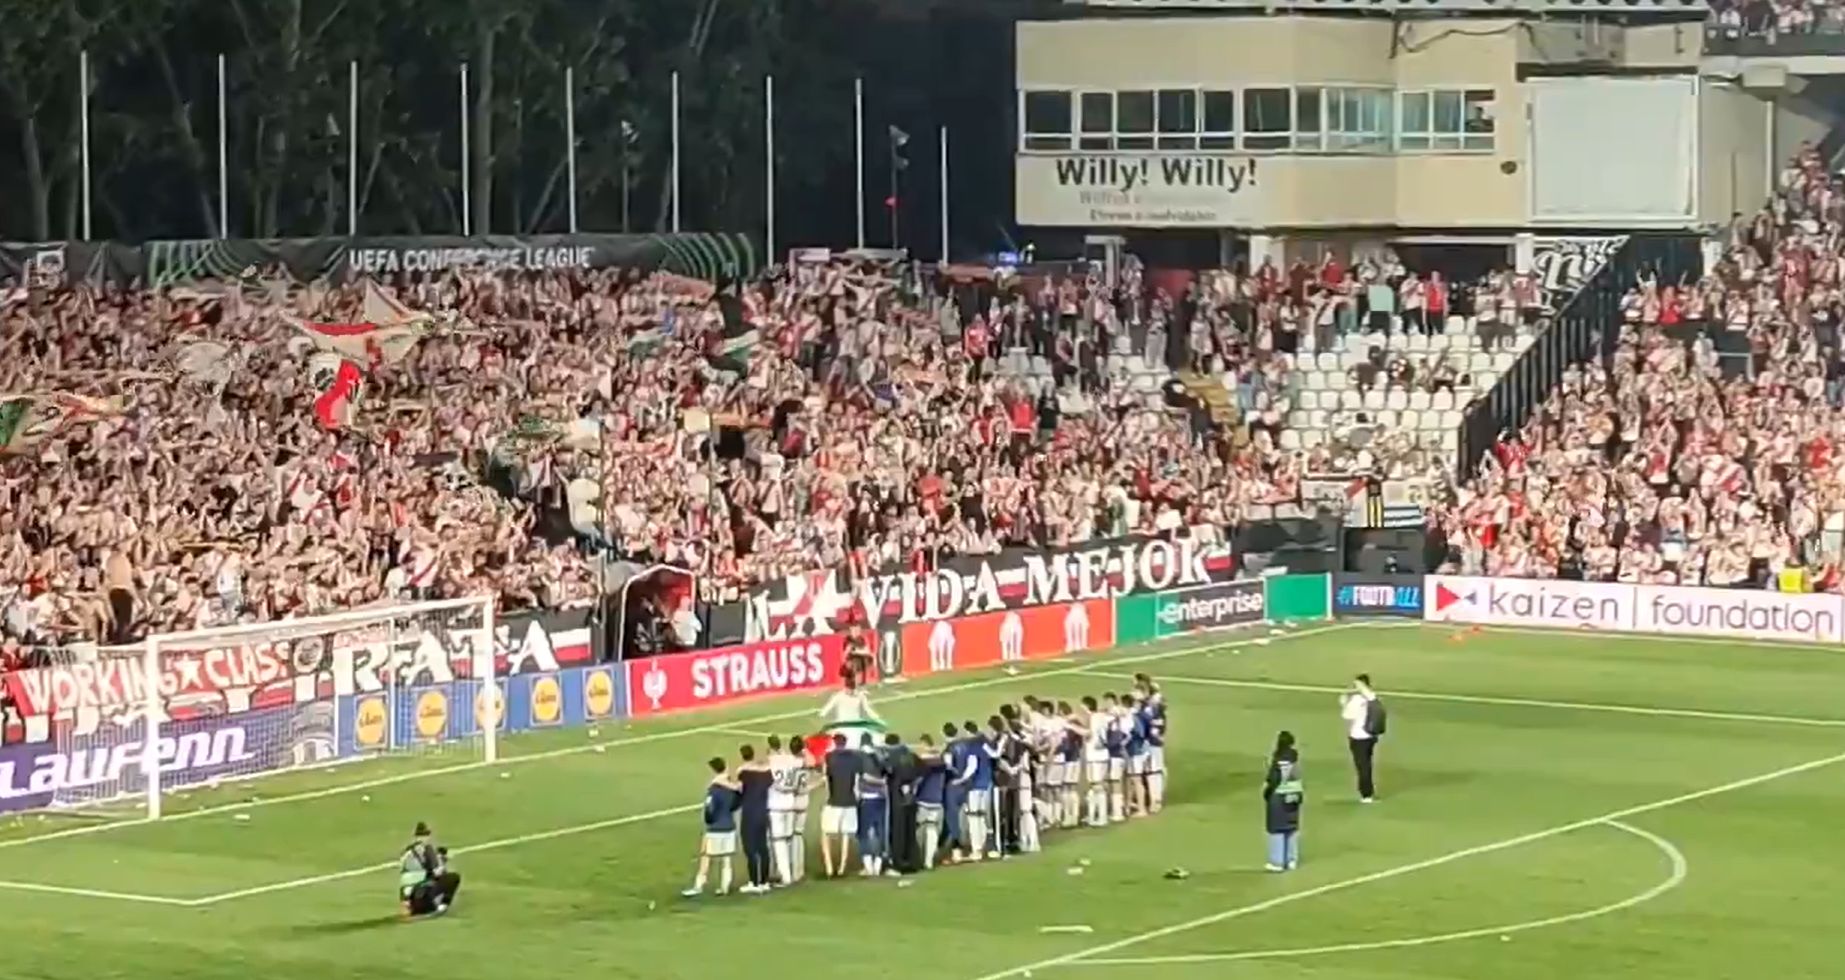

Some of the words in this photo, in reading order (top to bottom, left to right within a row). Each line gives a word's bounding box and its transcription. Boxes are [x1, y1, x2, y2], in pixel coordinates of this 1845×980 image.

[1056, 158, 1149, 192] Willy!
[1162, 158, 1257, 193] Willy!
[349, 250, 399, 272] UEFA
[403, 249, 521, 273] CONFCE
[525, 248, 592, 270] LEAGUE
[863, 560, 1006, 630] VIDA
[1159, 590, 1263, 622] enterprise
[1488, 583, 1619, 621] kaizen
[1651, 594, 1834, 634] foundation
[691, 642, 825, 698] STRAUSS
